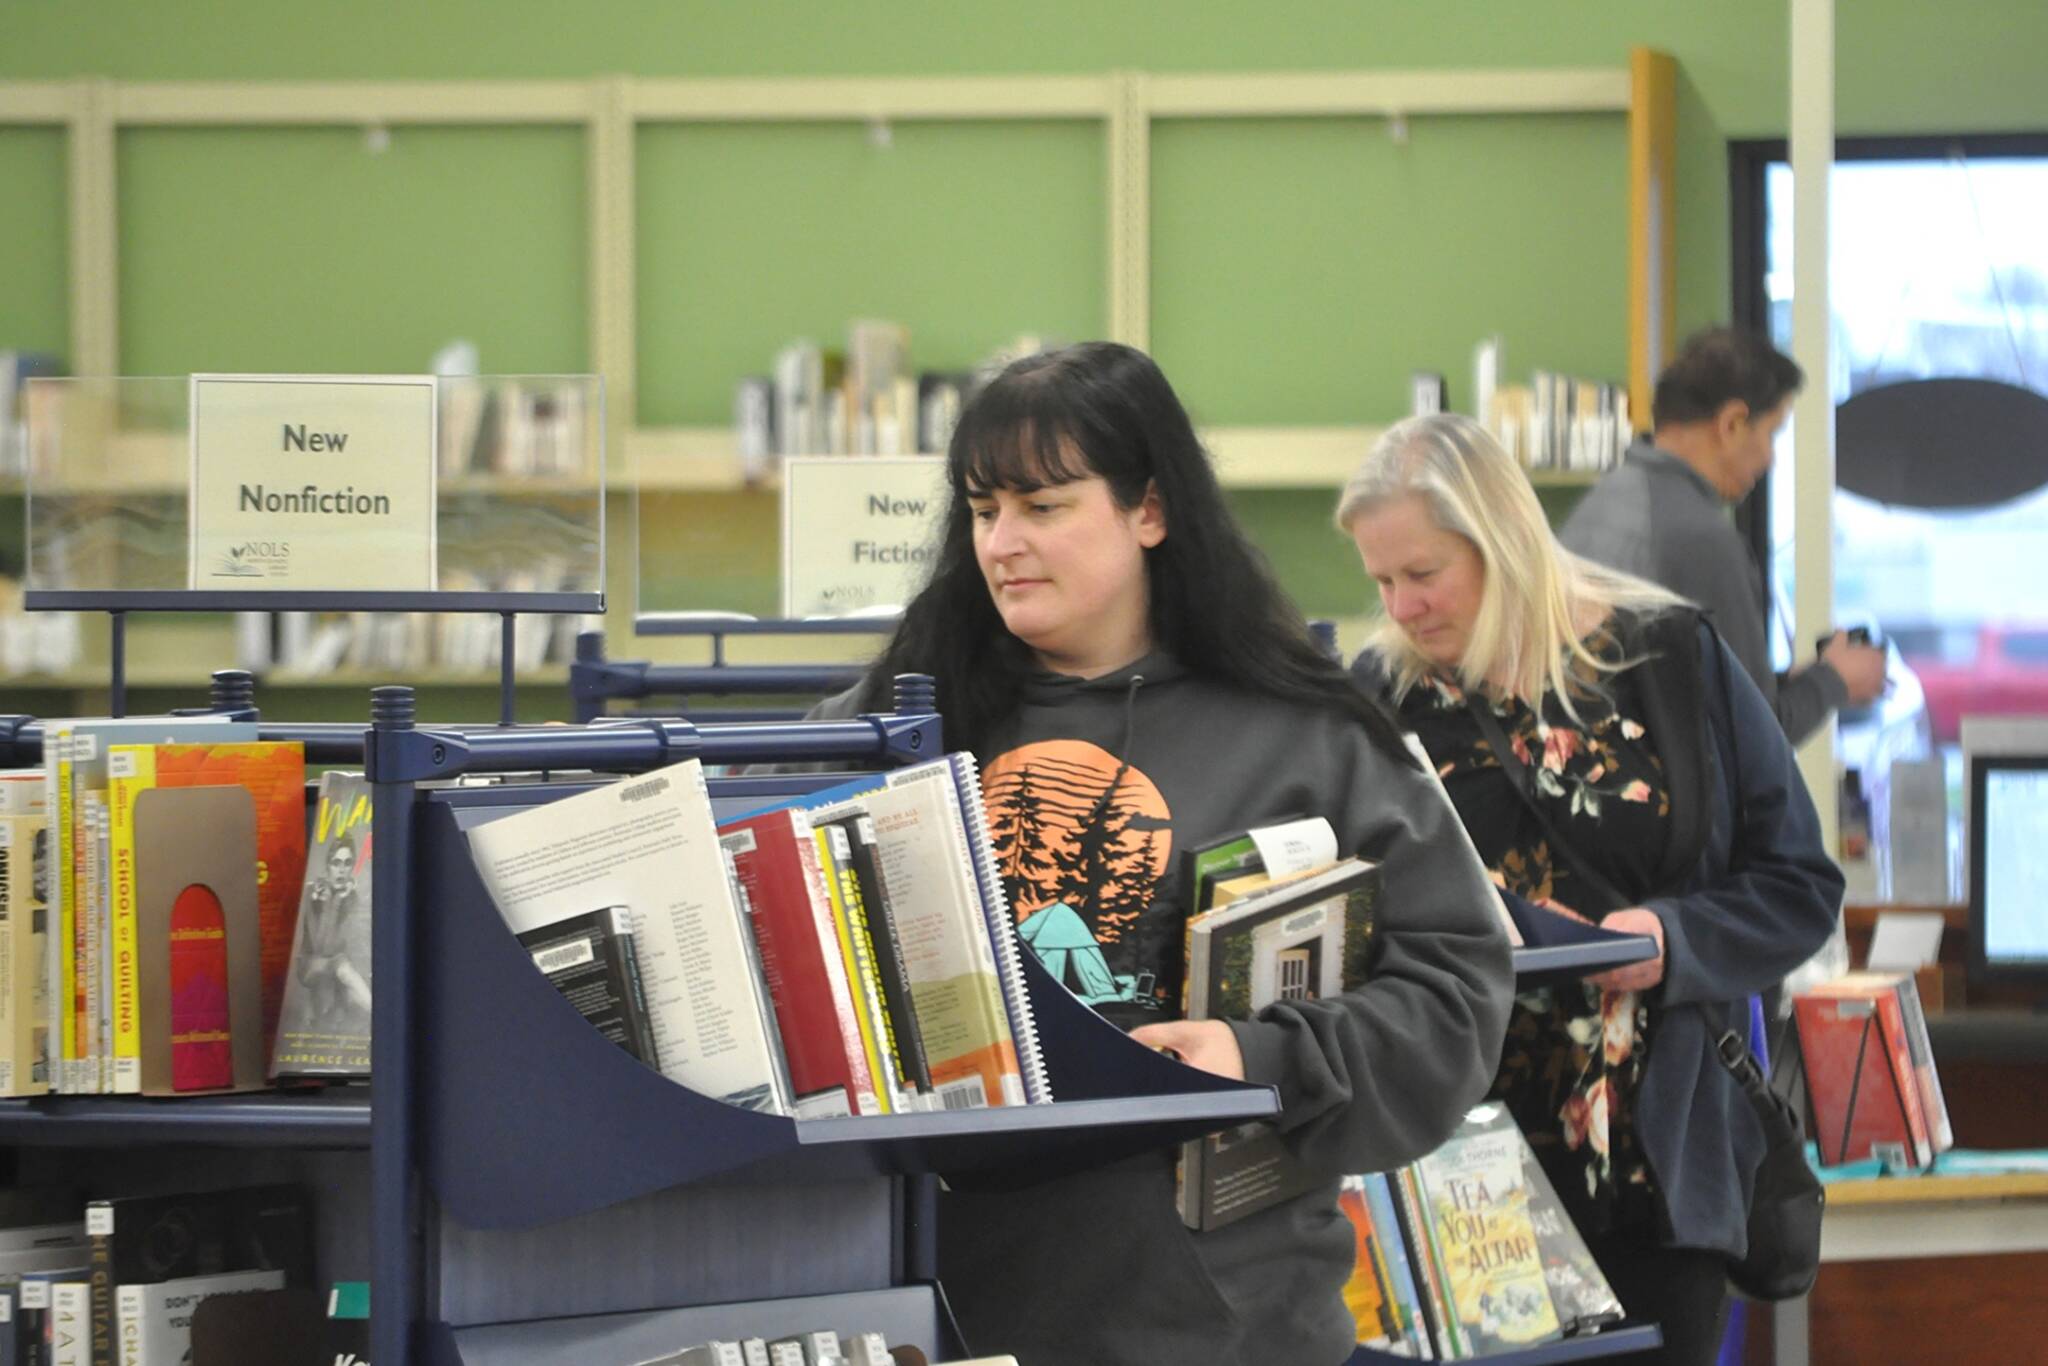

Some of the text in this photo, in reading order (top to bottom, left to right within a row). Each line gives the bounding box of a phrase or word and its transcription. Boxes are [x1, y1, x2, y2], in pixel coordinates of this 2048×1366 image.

[282, 424, 349, 453] New
[239, 484, 390, 514] Nonfiction
[868, 494, 927, 516] New
[245, 542, 290, 557] NOLS
[117, 848, 131, 920] SCHOOL
[893, 942, 910, 992] DRAMA
[118, 949, 133, 1034] QUILTING
[1443, 1177, 1494, 1213] TEA
[1441, 1212, 1486, 1245] YOU
[1469, 1237, 1532, 1276] ALTAR
[91, 1271, 110, 1351] GUITAR
